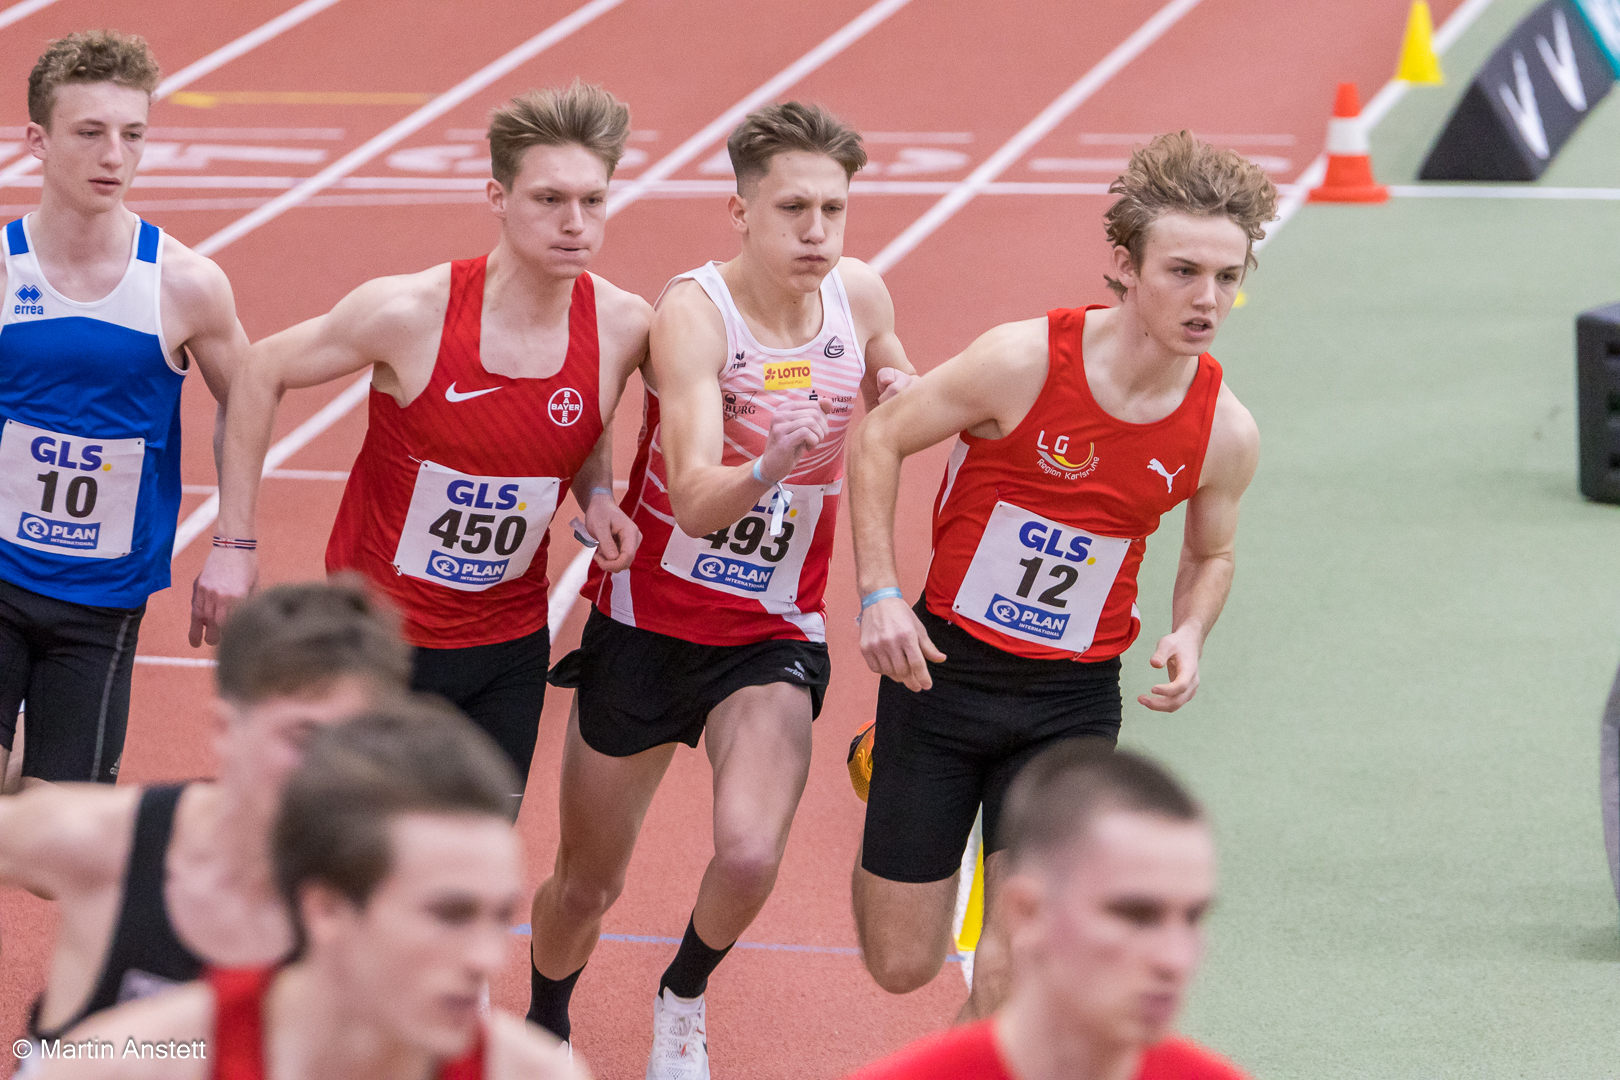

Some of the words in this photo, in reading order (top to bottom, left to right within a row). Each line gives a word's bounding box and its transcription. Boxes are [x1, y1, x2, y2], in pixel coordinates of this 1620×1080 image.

[14, 304, 44, 315] errea
[778, 366, 811, 379] LOTTO
[551, 403, 581, 411] BAYER
[1037, 458, 1062, 478] Region
[1064, 456, 1100, 480] Karlsruhe
[37, 470, 98, 518] 10
[51, 525, 97, 540] PLAN
[428, 508, 527, 556] 450
[50, 537, 95, 547] INTERNATIONAL
[461, 563, 505, 576] PLAN
[726, 563, 771, 583] PLAN
[460, 575, 500, 583] INTERNATIONAL
[724, 576, 765, 589] INTERNATIONAL
[1015, 556, 1079, 608] 12
[1021, 610, 1066, 631] PLAN
[1018, 623, 1060, 637] INTERNATIONAL
